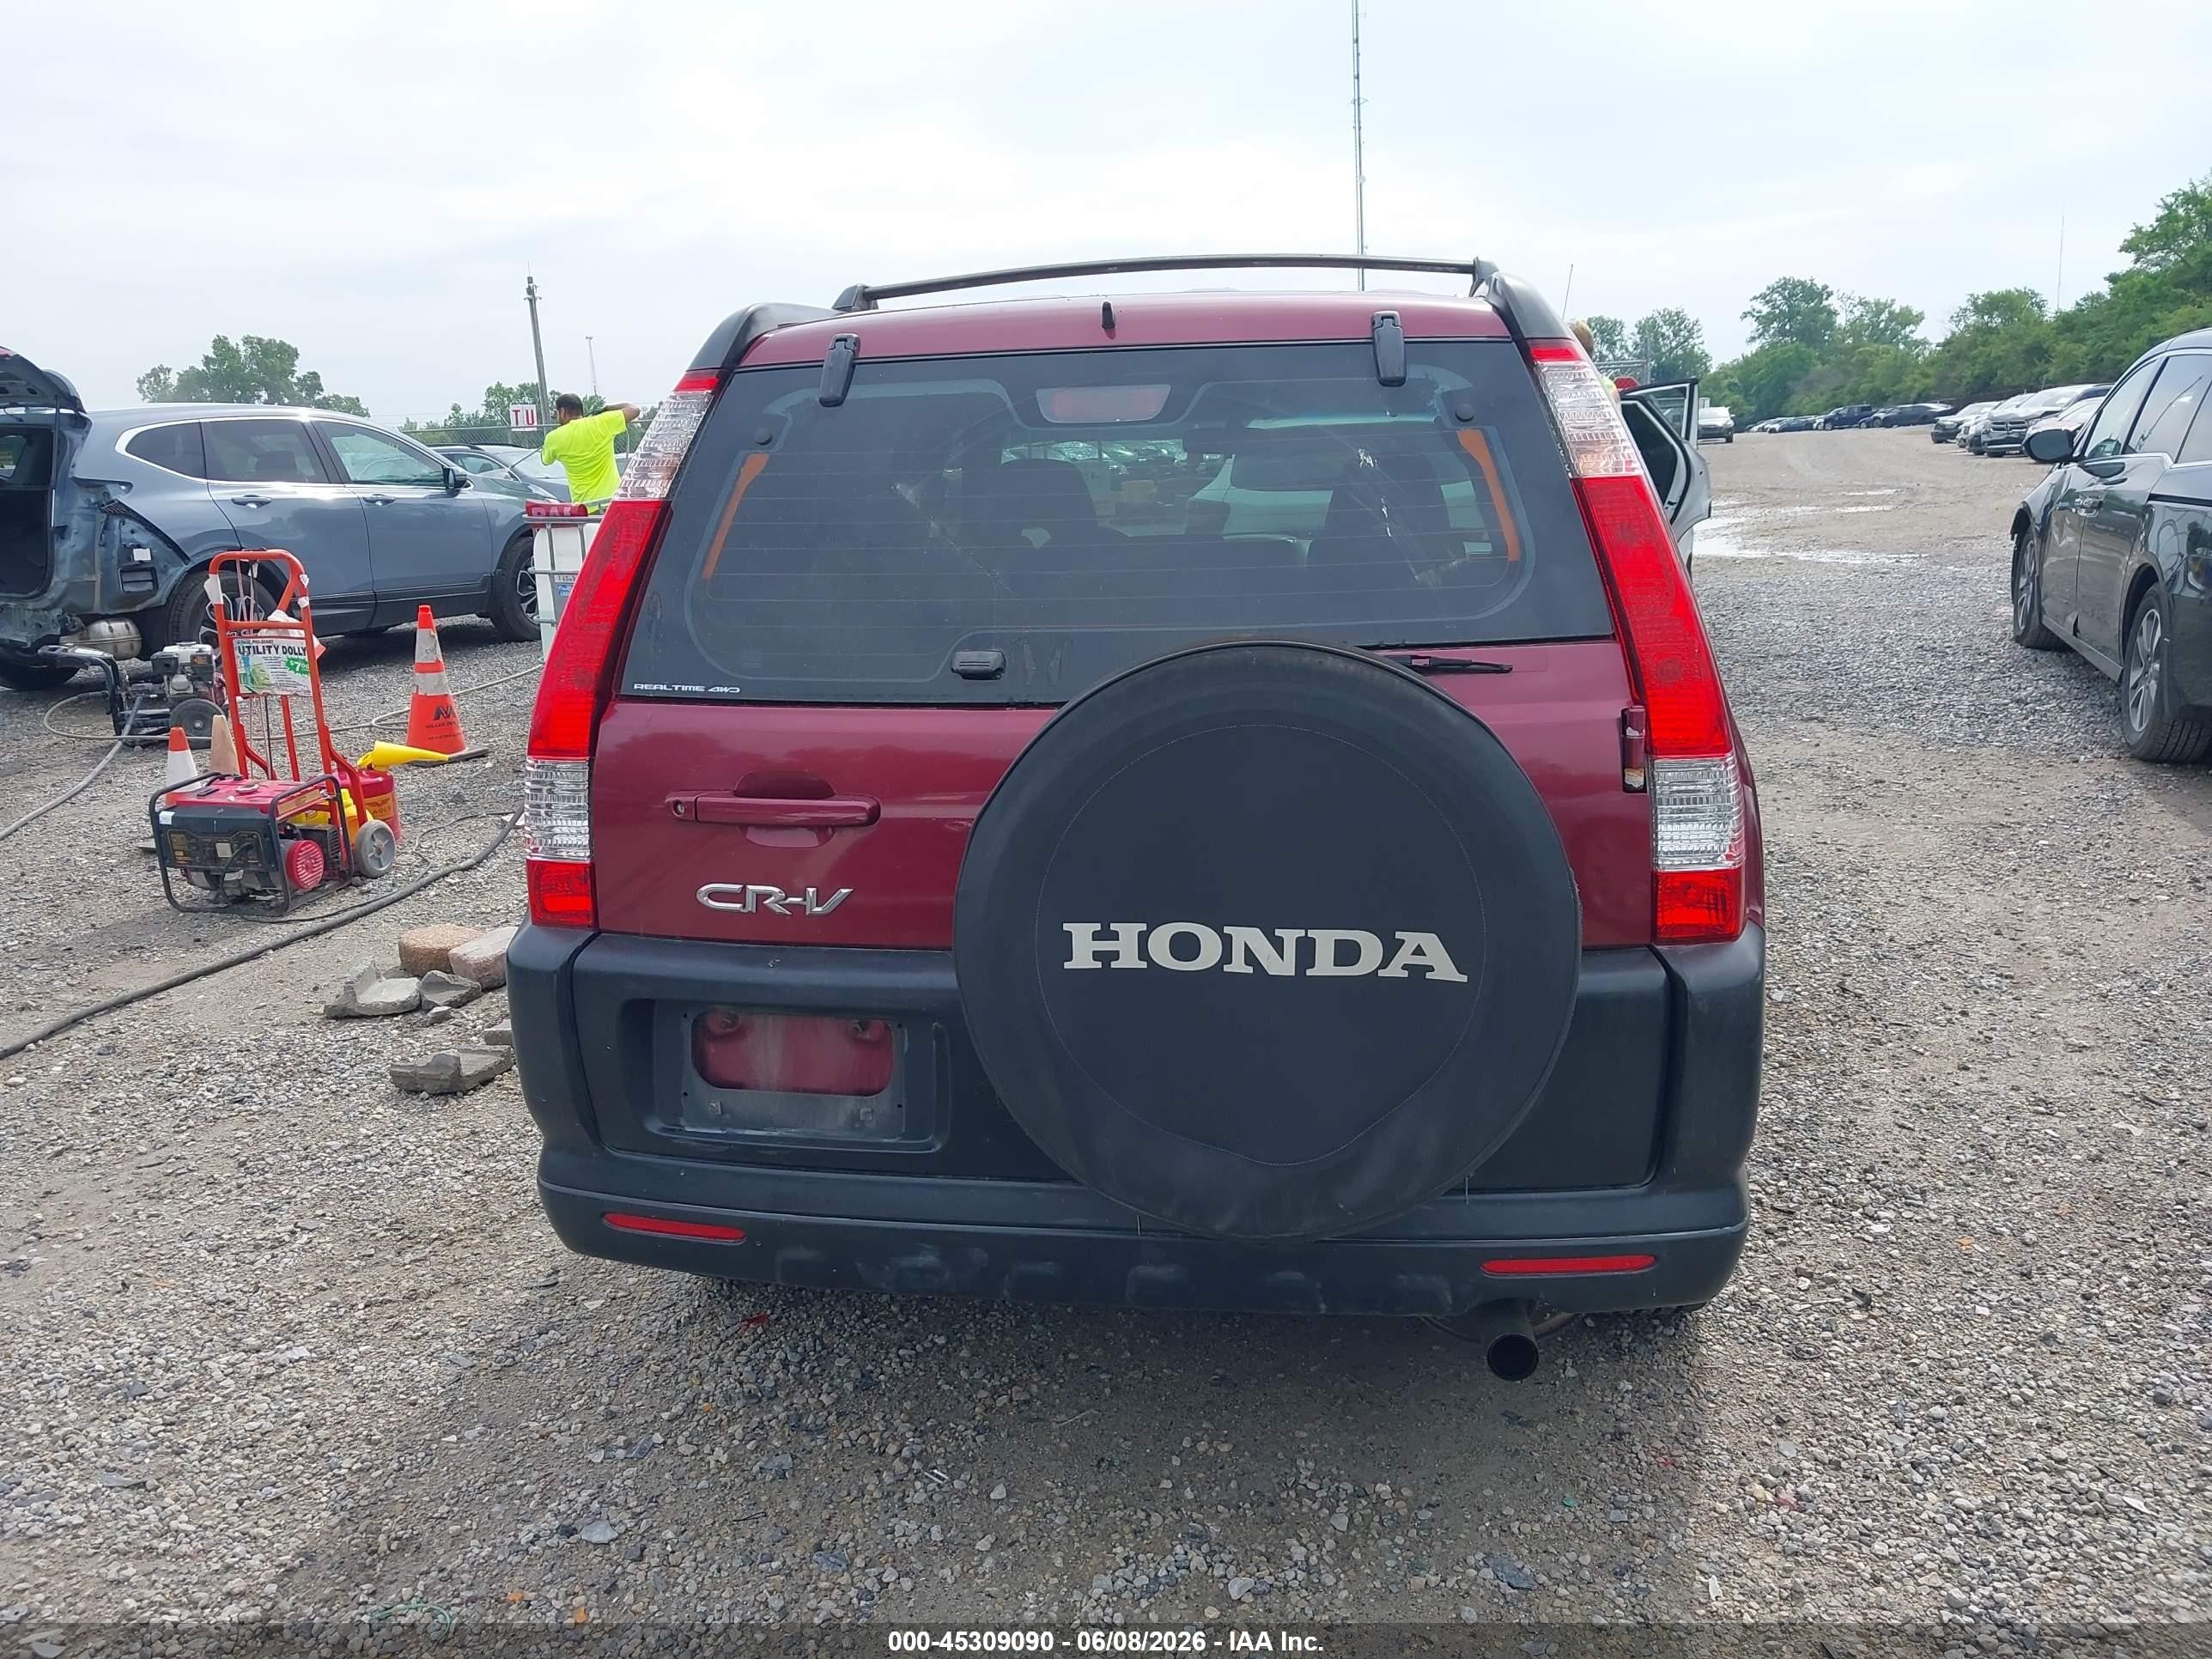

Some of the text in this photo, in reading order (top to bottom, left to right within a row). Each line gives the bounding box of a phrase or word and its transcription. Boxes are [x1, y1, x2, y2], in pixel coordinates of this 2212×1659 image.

[237, 645, 307, 656] UTILITY DOLLY
[634, 684, 705, 692] REALTIME
[696, 883, 854, 915] CR-V
[1062, 921, 1468, 983] HONDA
